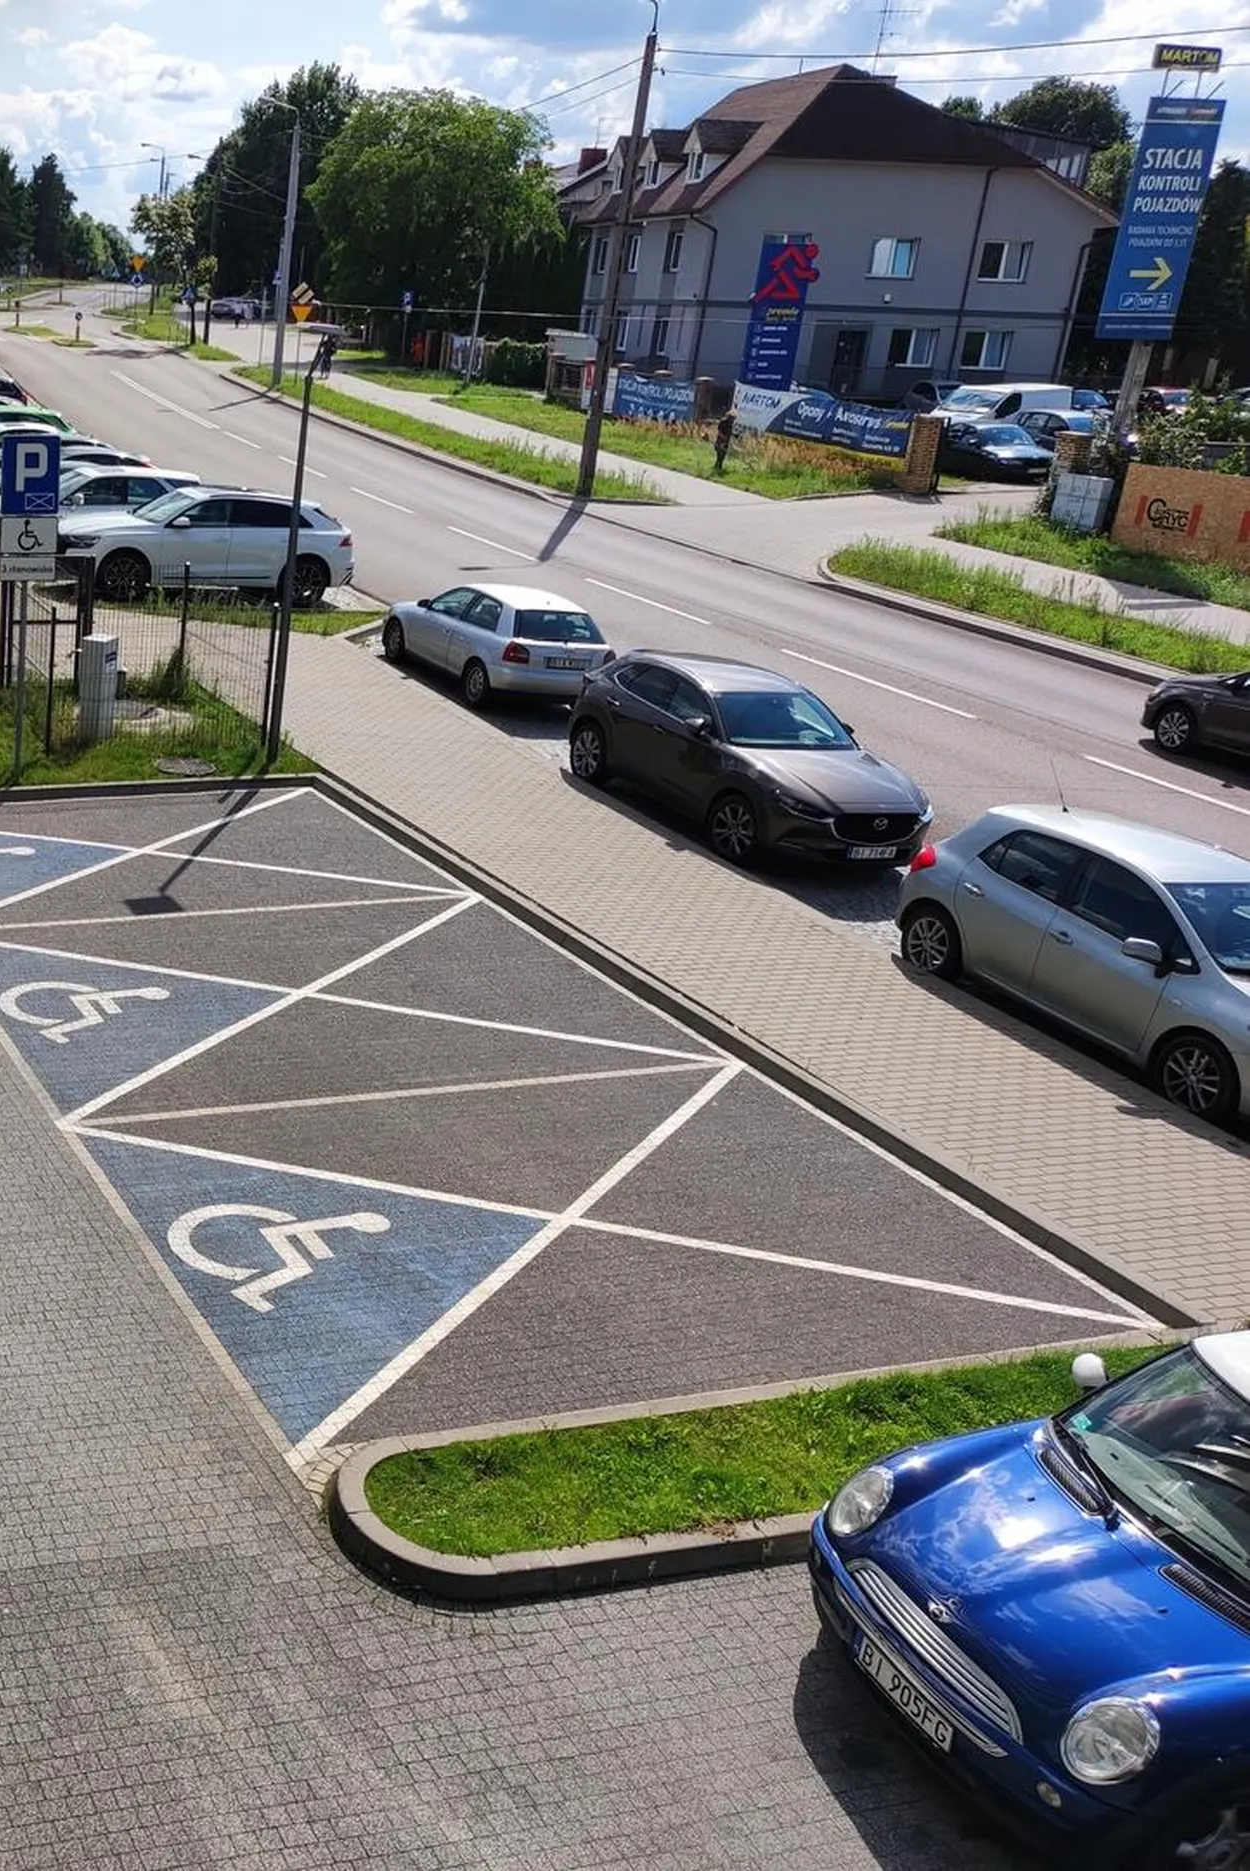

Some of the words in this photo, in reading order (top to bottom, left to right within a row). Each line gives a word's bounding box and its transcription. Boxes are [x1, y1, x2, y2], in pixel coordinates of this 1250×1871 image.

[1161, 49, 1219, 63] MARTOM
[1143, 149, 1204, 170] STACJA
[1138, 175, 1201, 192] KONTROLI
[1133, 196, 1203, 214] POJAZDÓW
[15, 442, 49, 493] P
[862, 1643, 883, 1678] BI
[889, 1674, 949, 1744] 905FG
